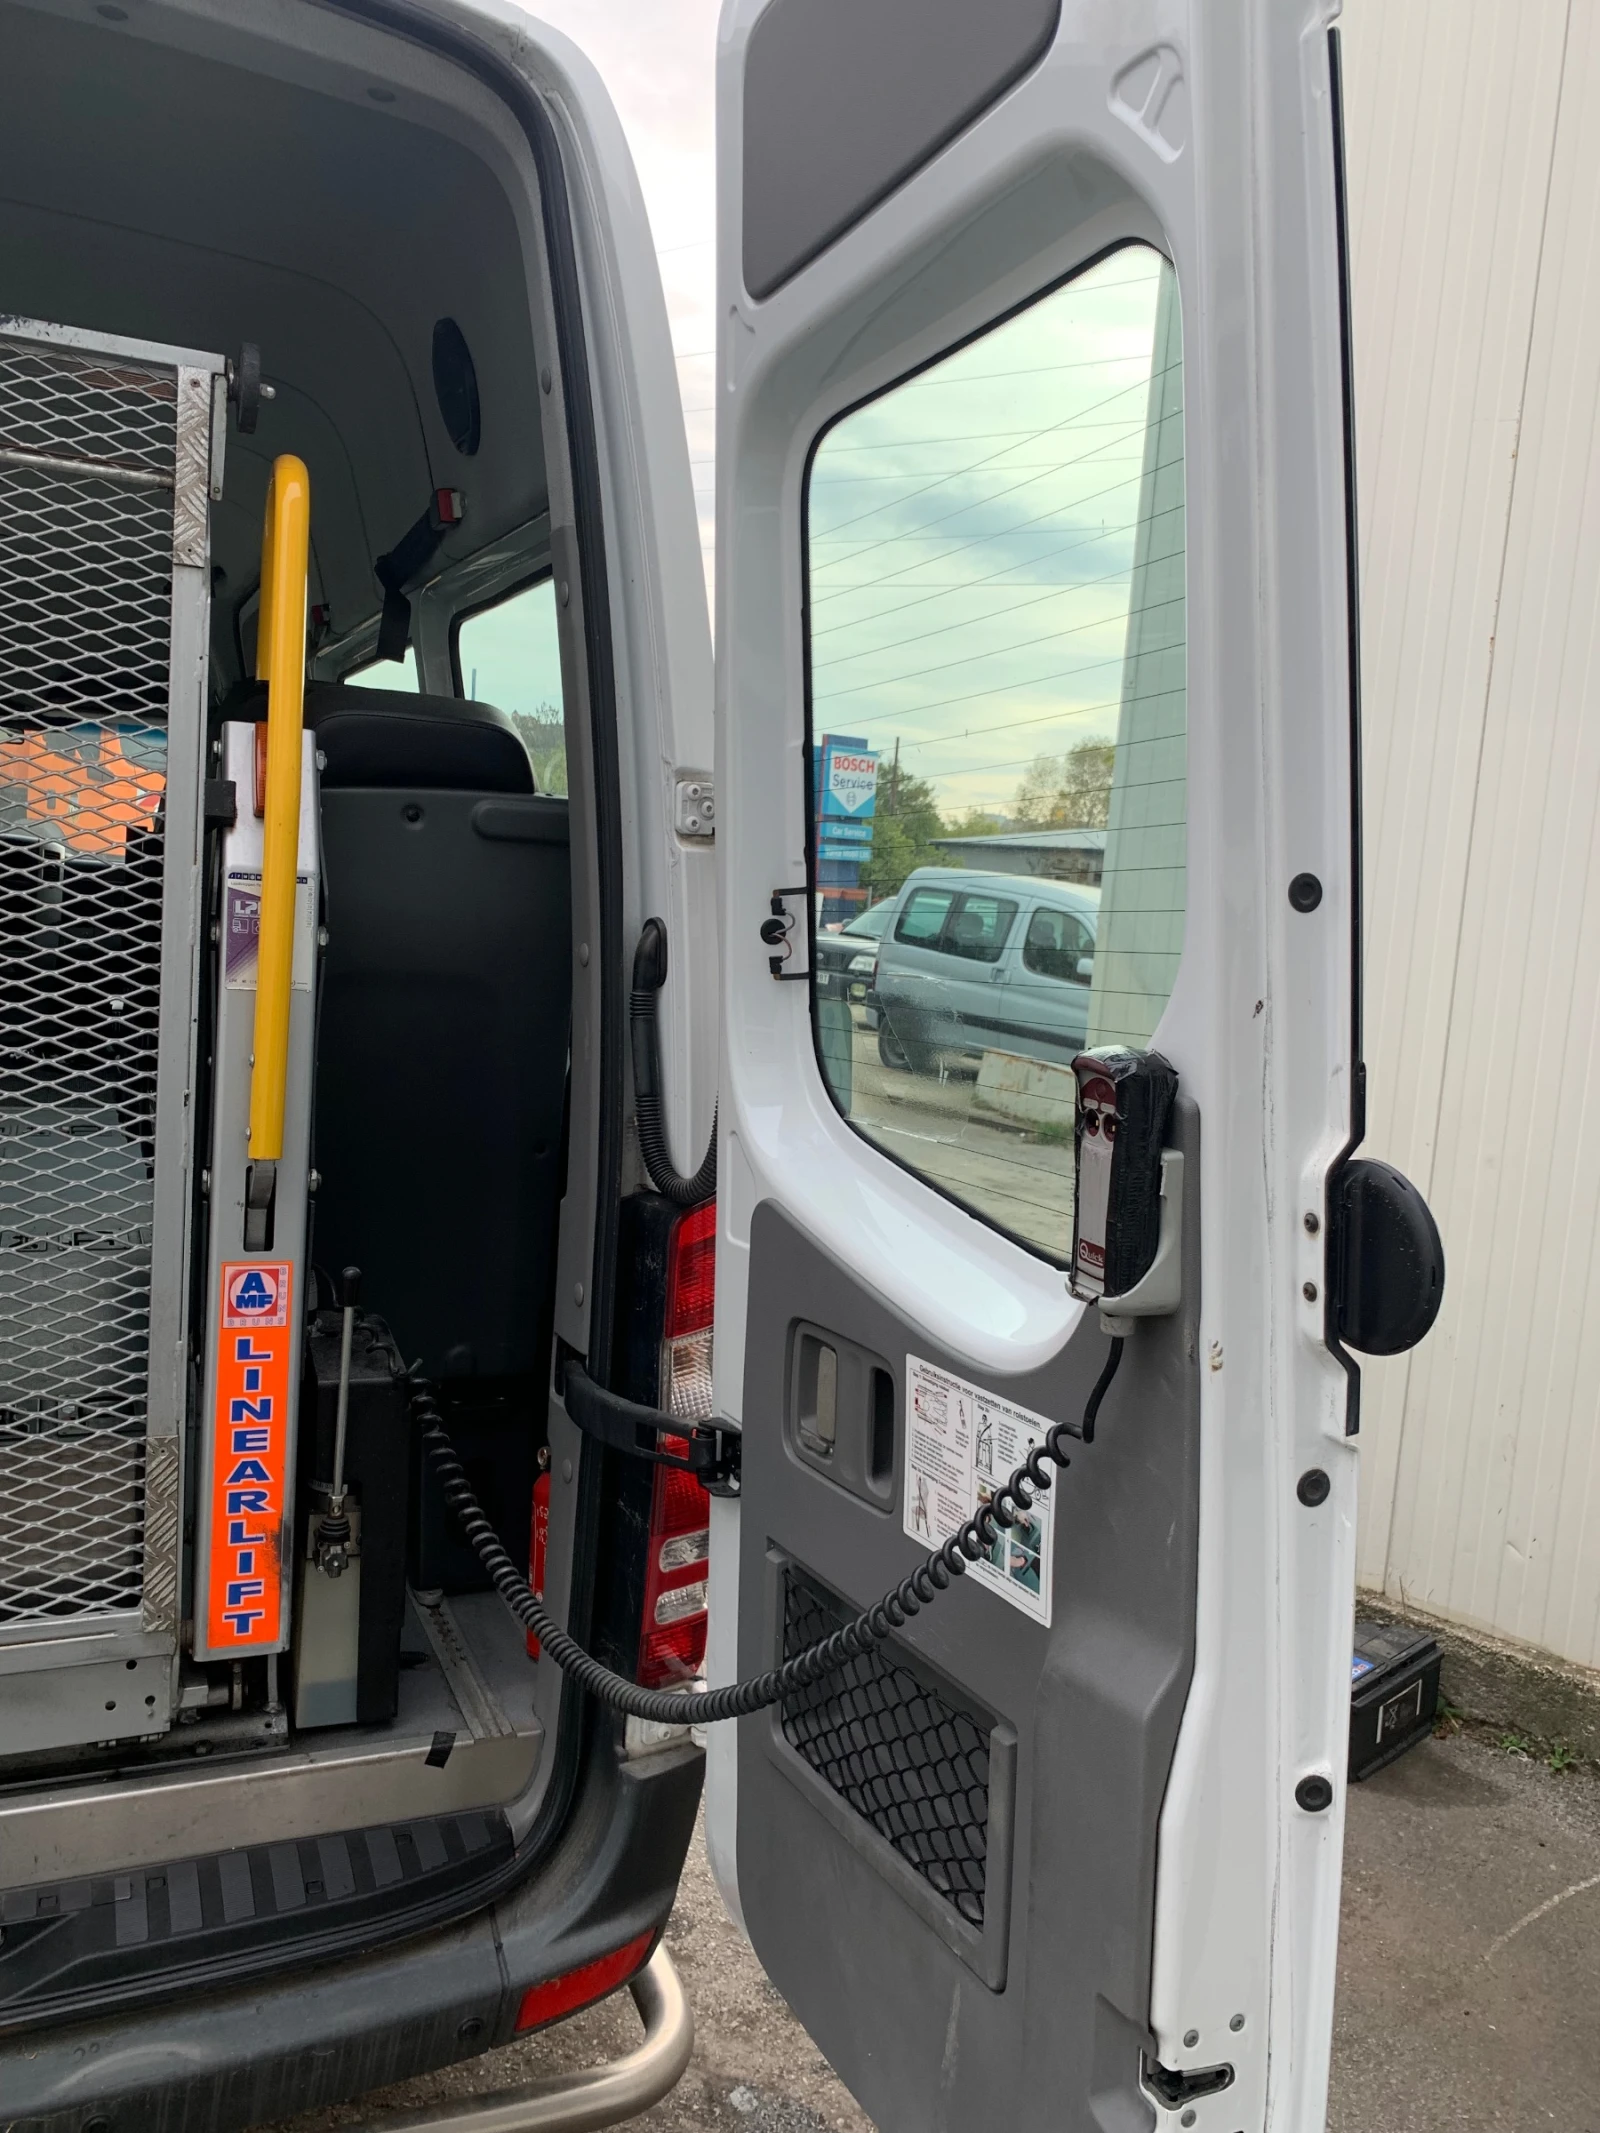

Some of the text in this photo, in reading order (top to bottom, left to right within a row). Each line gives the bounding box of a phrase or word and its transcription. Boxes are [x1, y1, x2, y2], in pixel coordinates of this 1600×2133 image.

[833, 756, 875, 774] BOSCH
[832, 774, 874, 791] Service
[1080, 1243, 1104, 1266] Quick
[919, 1363, 961, 1390] Gebruiksinstructie
[962, 1386, 973, 1397] voor
[974, 1391, 1000, 1410] vastzetten
[1001, 1405, 1012, 1415] van
[223, 1335, 276, 1636] LINEARLIFT
